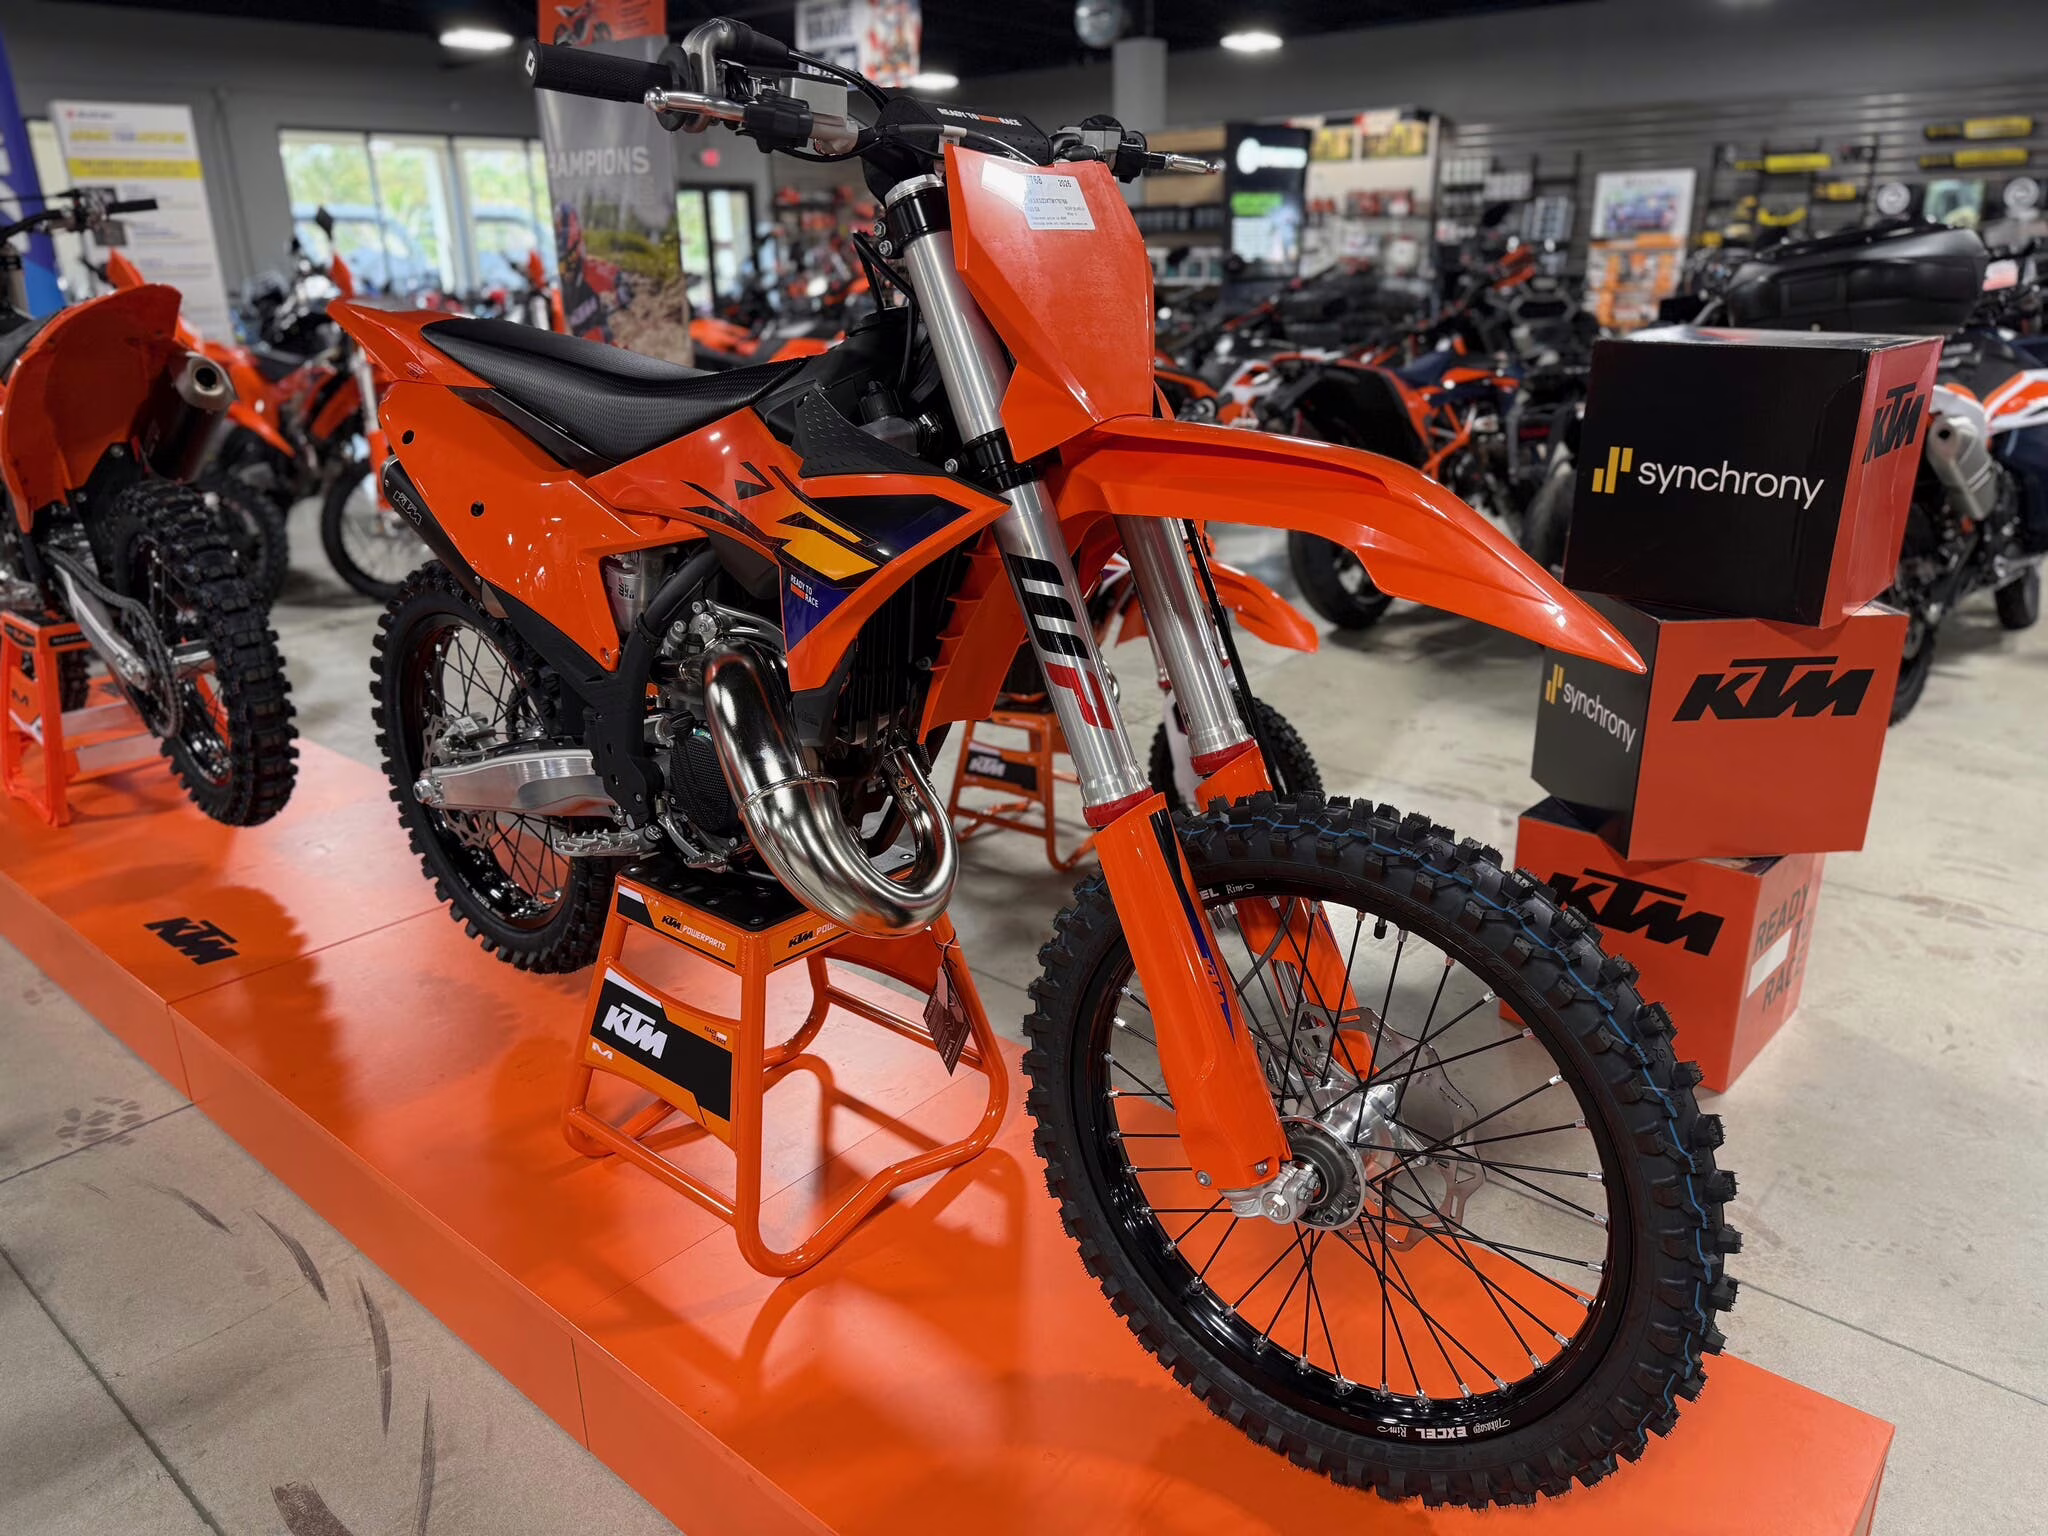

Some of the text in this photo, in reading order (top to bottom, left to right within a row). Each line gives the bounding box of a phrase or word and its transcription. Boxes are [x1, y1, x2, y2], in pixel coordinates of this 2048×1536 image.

[549, 147, 650, 178] HAMPIONS
[1862, 383, 1926, 464] KTM
[1638, 460, 1824, 510] synchrony
[790, 574, 813, 596] READY TO
[804, 593, 819, 608] RACE
[1672, 656, 1875, 722] KTM
[1563, 682, 1636, 752] synchrony
[661, 915, 682, 931] KTM
[1547, 867, 1725, 956] KTM
[1754, 882, 1810, 958] READY
[143, 917, 240, 965] KTM
[788, 931, 814, 949] KTM
[601, 1002, 668, 1059] KTM
[1415, 1425, 1468, 1439] EXCEL
